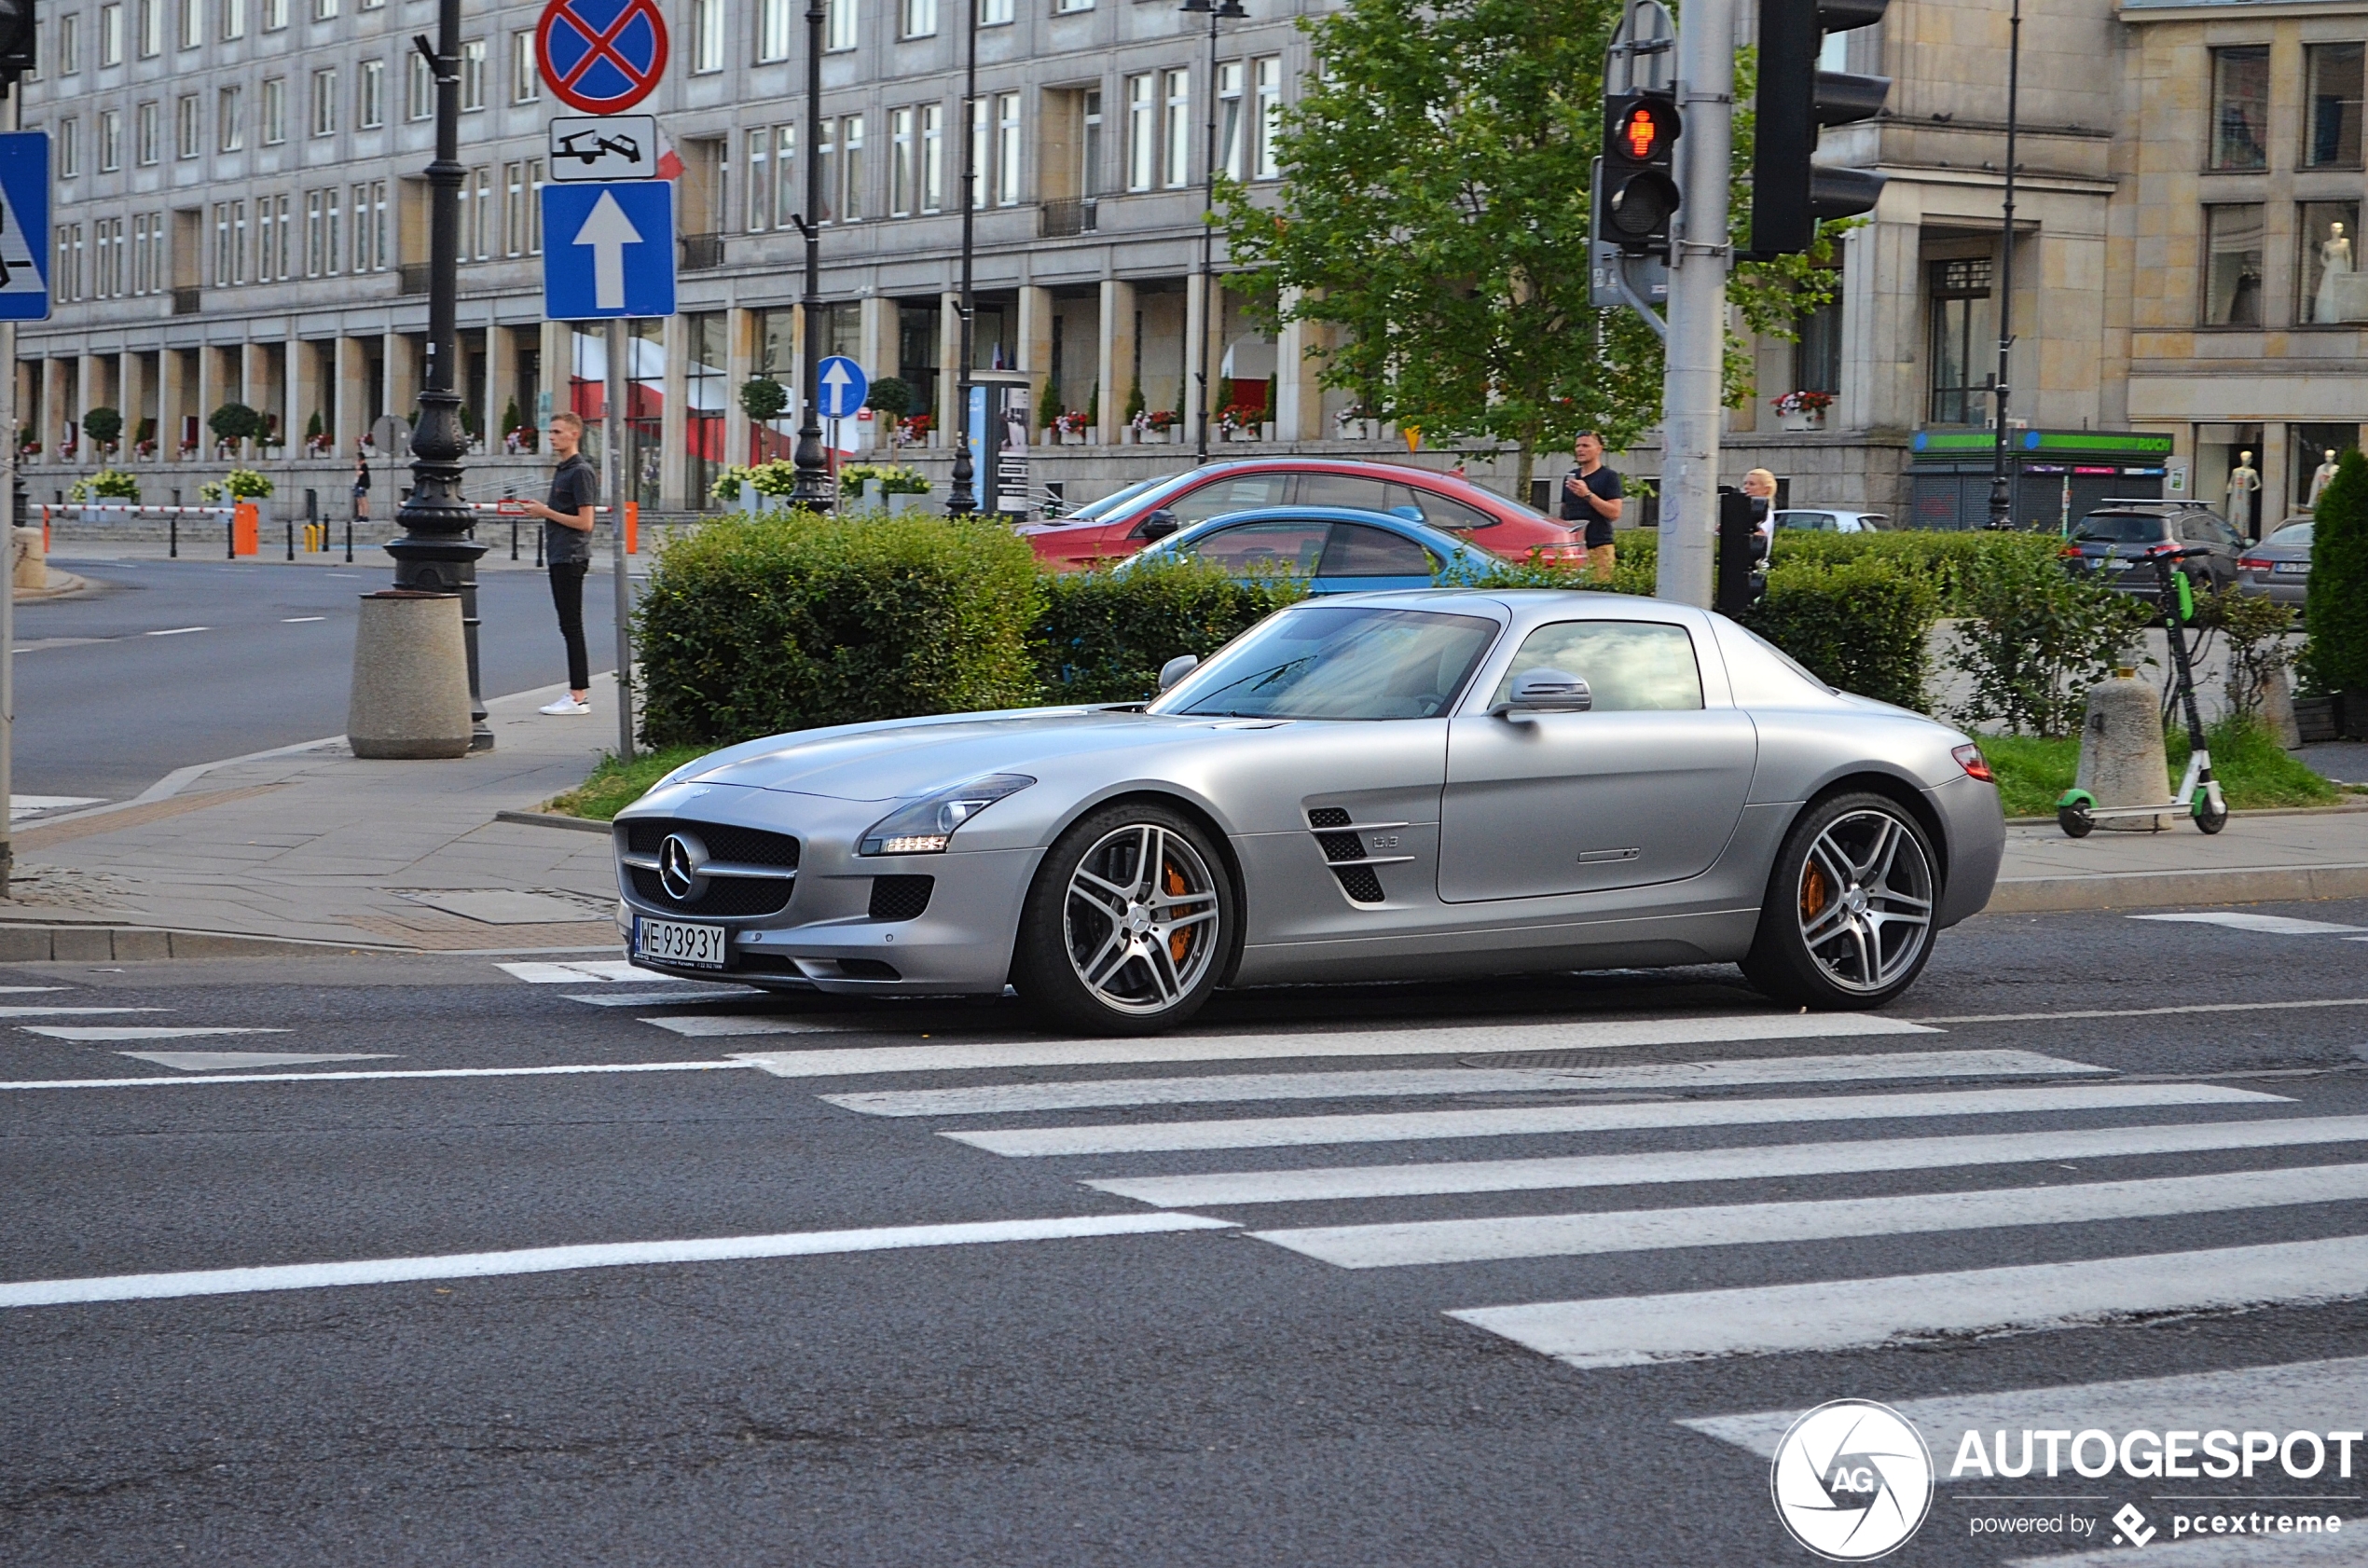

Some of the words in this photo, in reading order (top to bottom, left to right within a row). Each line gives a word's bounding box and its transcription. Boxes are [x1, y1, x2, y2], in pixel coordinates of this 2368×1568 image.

[1373, 835, 1399, 848] 6.3
[641, 920, 660, 953] WE
[664, 925, 723, 961] 9393Y
